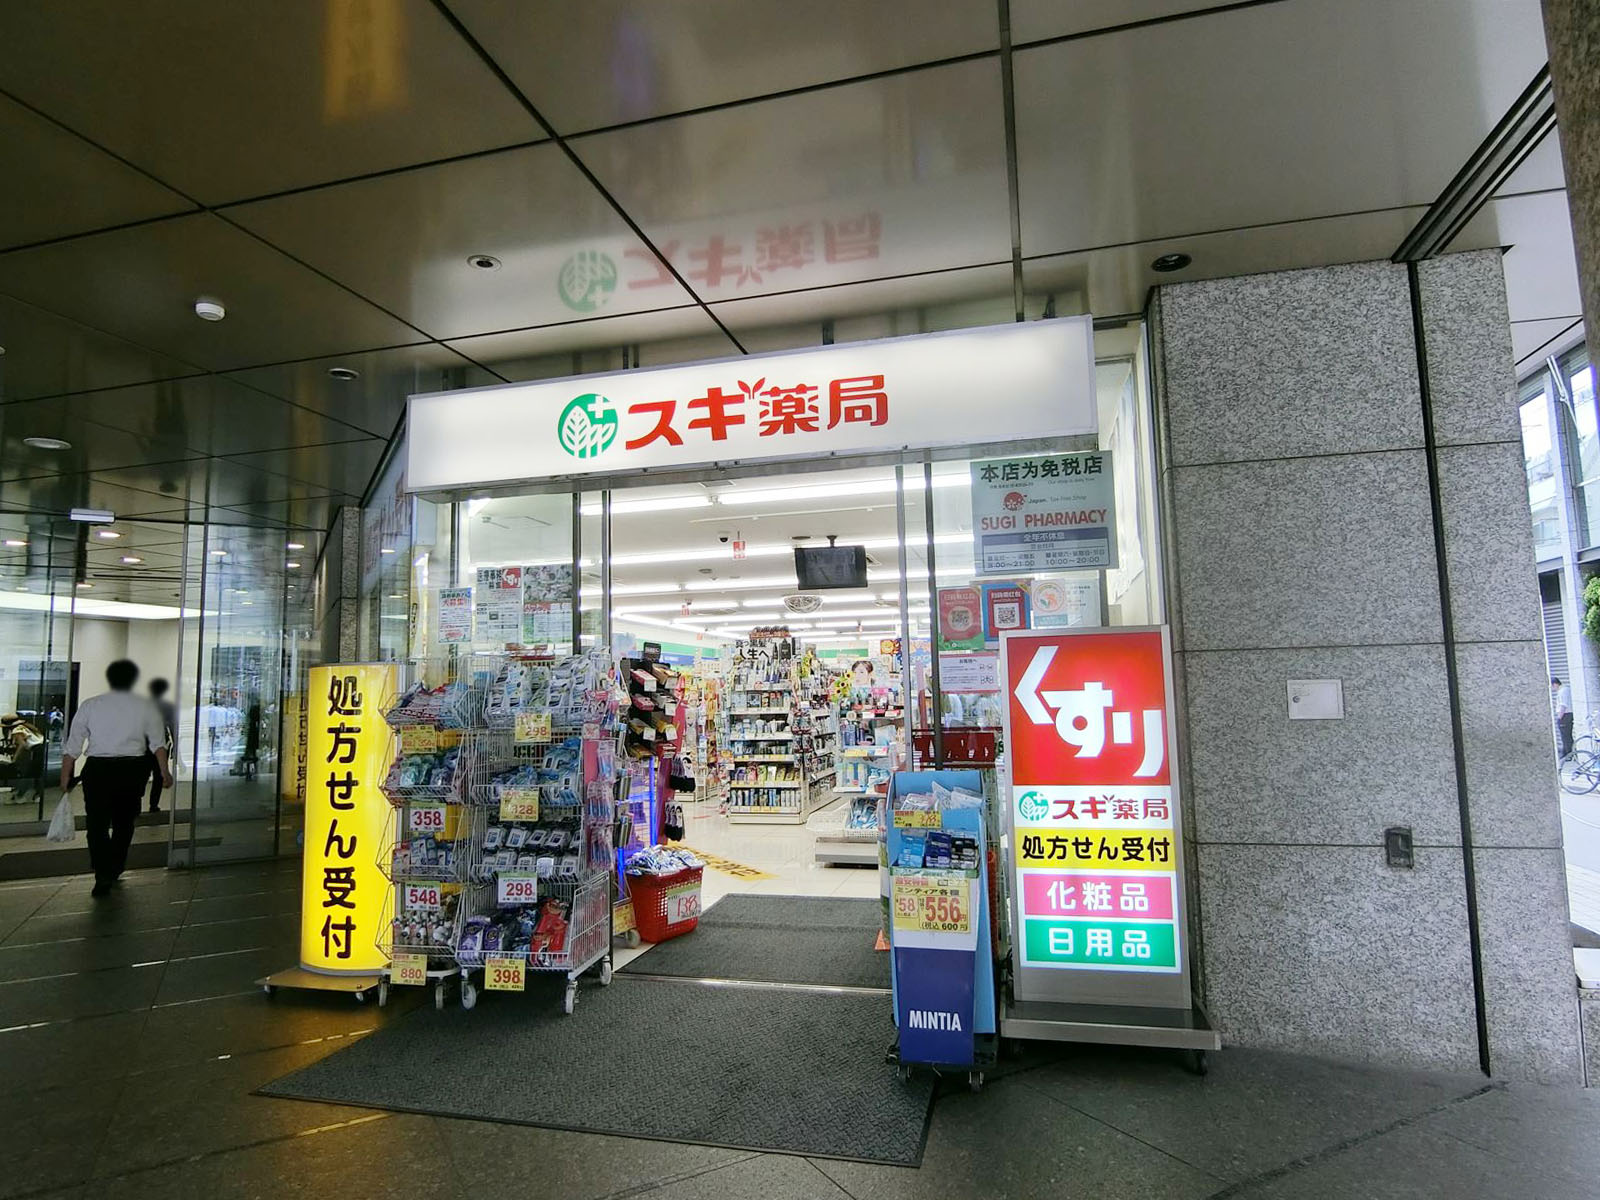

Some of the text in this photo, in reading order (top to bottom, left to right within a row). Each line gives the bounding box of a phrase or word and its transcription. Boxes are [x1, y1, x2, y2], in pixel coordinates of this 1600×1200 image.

[625, 374, 889, 450] スギ薬局
[980, 456, 1103, 483] 本店为免税店
[981, 509, 1108, 531] SUGI PHARMACY
[1014, 645, 1164, 777] くすり
[321, 675, 363, 960] 処方せん受付
[413, 811, 441, 826] 358
[1052, 794, 1169, 821] スギ薬局
[1022, 835, 1171, 863] 処方せん受付
[410, 889, 437, 905] 548
[506, 883, 532, 896] 298
[1046, 880, 1149, 912] 化粧品
[1047, 927, 1151, 959] 日用品
[493, 969, 520, 983] 398
[908, 1010, 962, 1032] MINTIA
